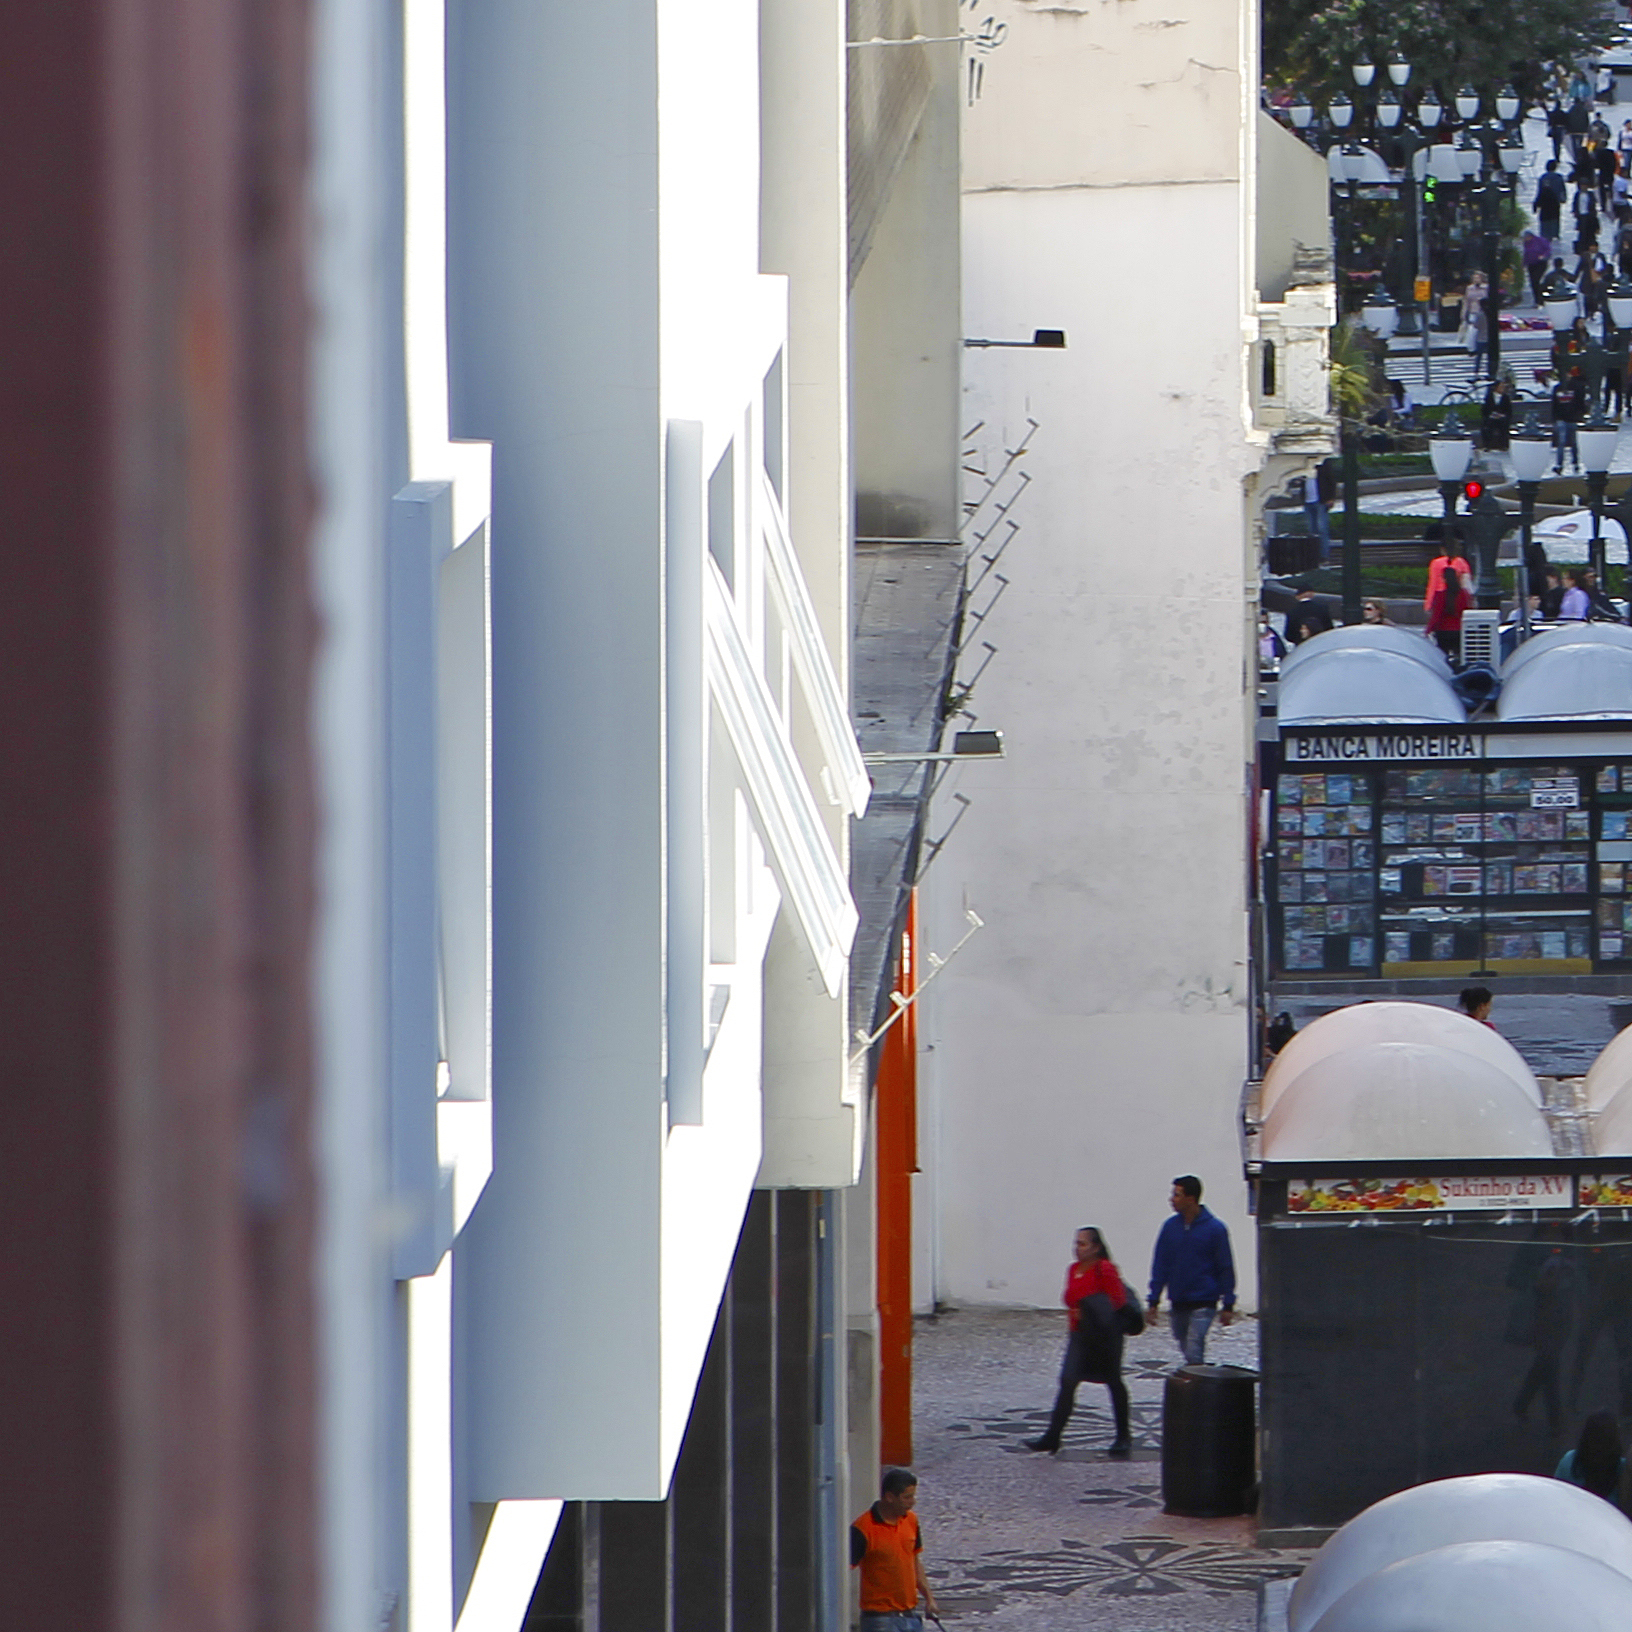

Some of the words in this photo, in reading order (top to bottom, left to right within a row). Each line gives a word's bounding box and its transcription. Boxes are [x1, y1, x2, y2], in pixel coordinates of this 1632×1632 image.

[1297, 737, 1369, 759] BANCA
[1376, 734, 1475, 758] MOREIRA
[1441, 1177, 1511, 1197] Sukinho
[1516, 1176, 1535, 1194] da
[1540, 1175, 1567, 1194] XV
